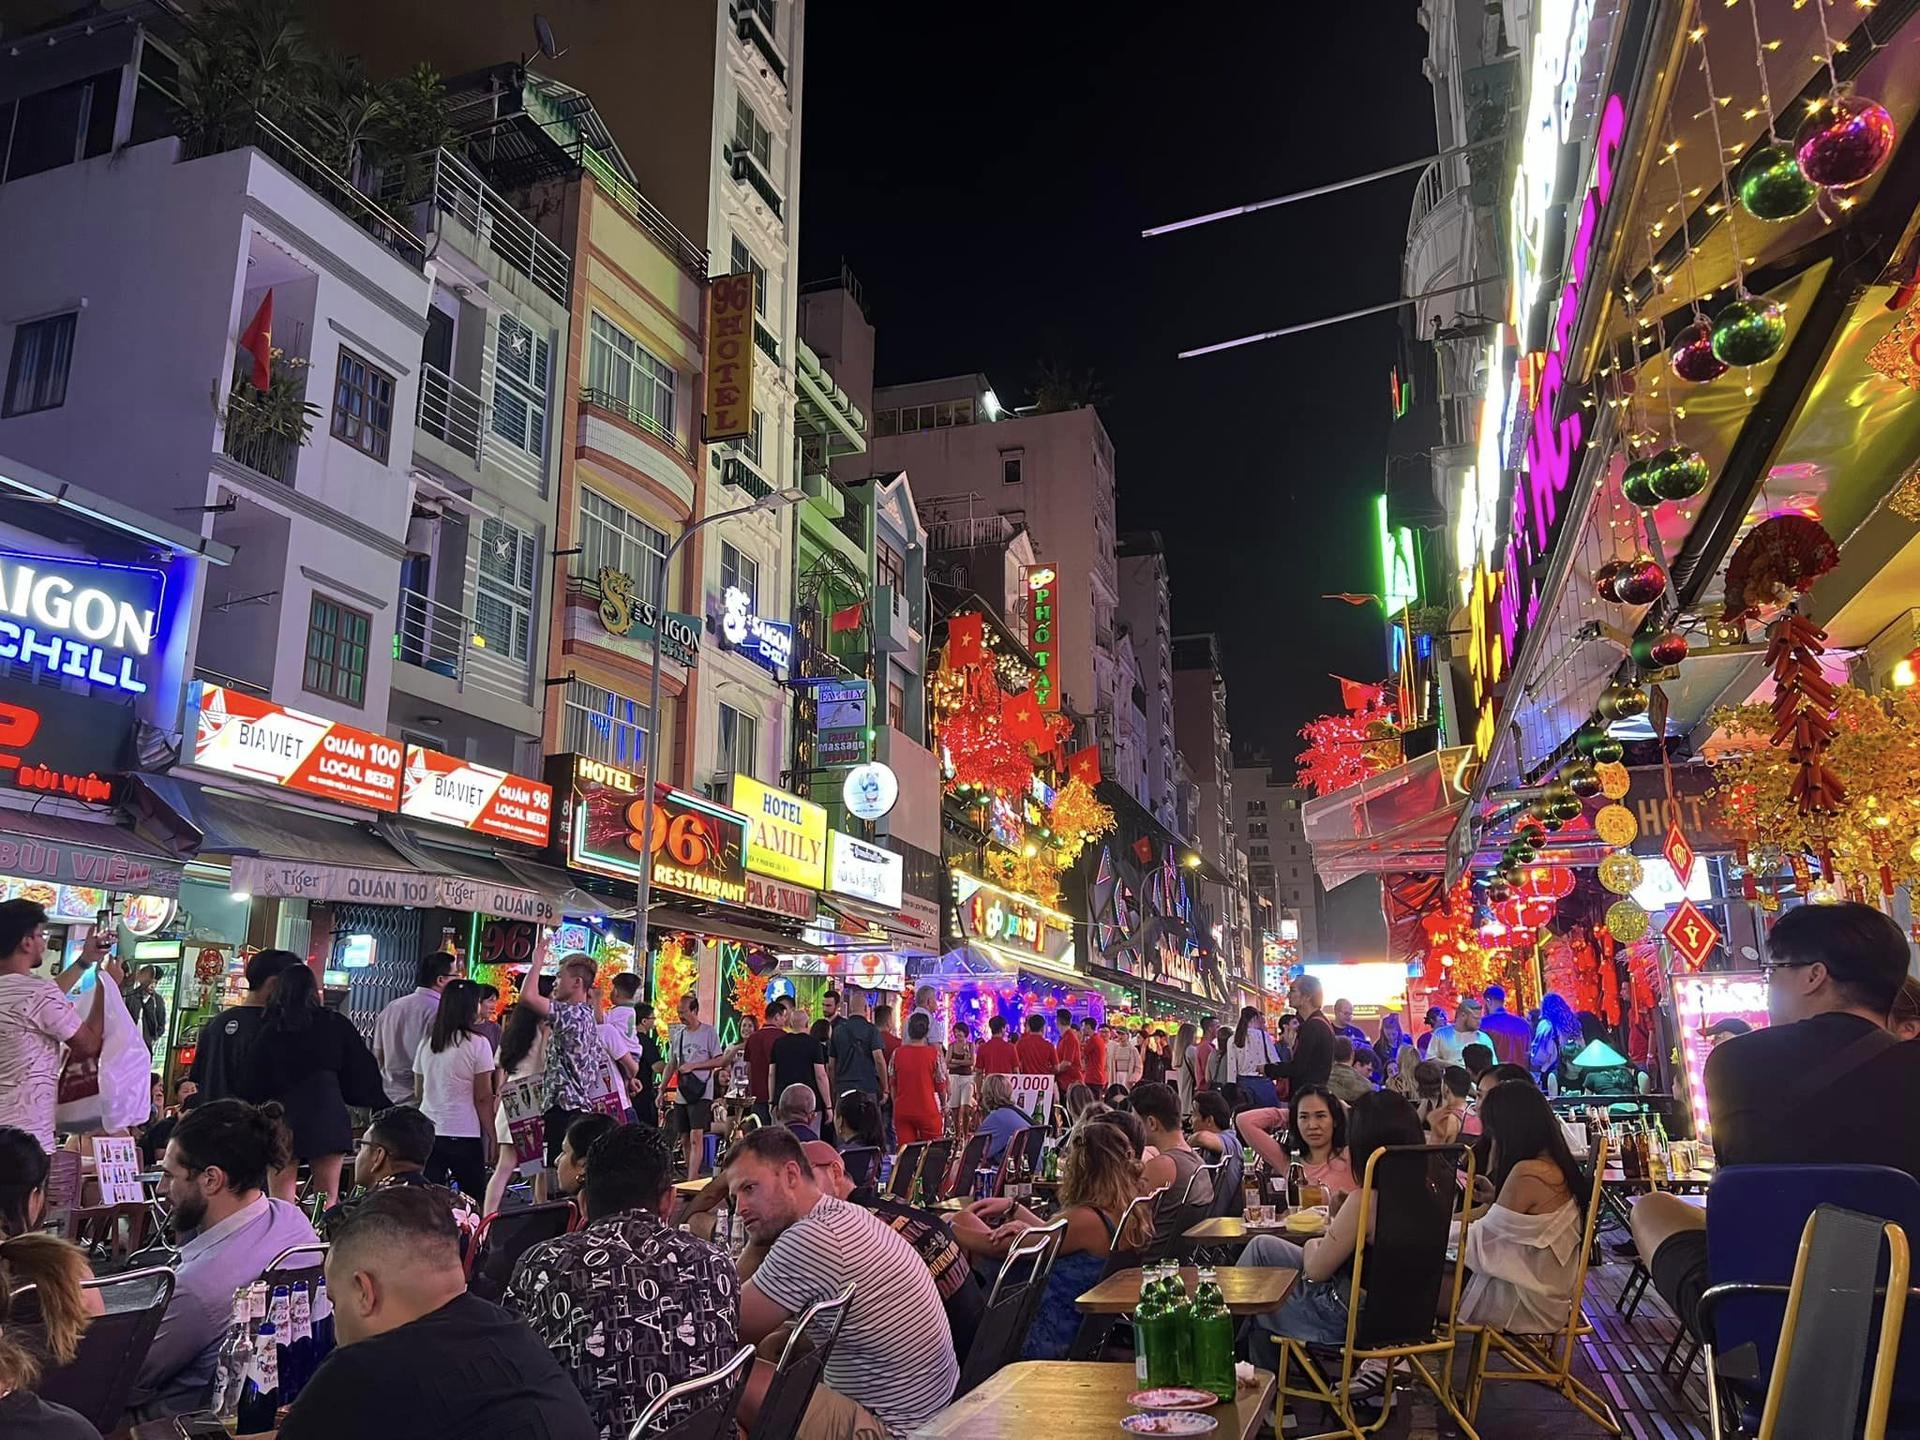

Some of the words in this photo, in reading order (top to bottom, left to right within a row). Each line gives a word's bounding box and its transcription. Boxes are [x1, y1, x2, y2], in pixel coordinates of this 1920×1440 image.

[713, 279, 749, 315] 96
[714, 314, 744, 432] HOTEL
[751, 616, 791, 657] SAIGON
[239, 722, 266, 751] BIA
[323, 734, 366, 761] QUÁN
[368, 742, 402, 770] 100
[818, 740, 866, 753] Massage
[19, 762, 60, 791] BÙI
[319, 756, 363, 782] LOCAL
[364, 768, 395, 791] BEER
[435, 777, 455, 800] BIA
[579, 757, 635, 793] HOTEL
[495, 802, 526, 821] LOCAL
[498, 784, 531, 806] QUÁN
[532, 790, 549, 810] 98
[763, 792, 803, 826] HOTEL
[625, 799, 706, 866] 96
[749, 816, 823, 866] AMILY
[0, 838, 60, 877] BÙI
[281, 869, 320, 894] Tiger
[347, 876, 397, 900] QUÁN
[402, 880, 429, 902] 100
[444, 881, 475, 905] Tiger
[653, 864, 747, 904] RESTAURANT
[746, 878, 764, 906] PA
[778, 888, 811, 918] NAIL
[493, 894, 534, 916] QUÁN
[536, 902, 553, 919] 98
[481, 922, 532, 961] 96
